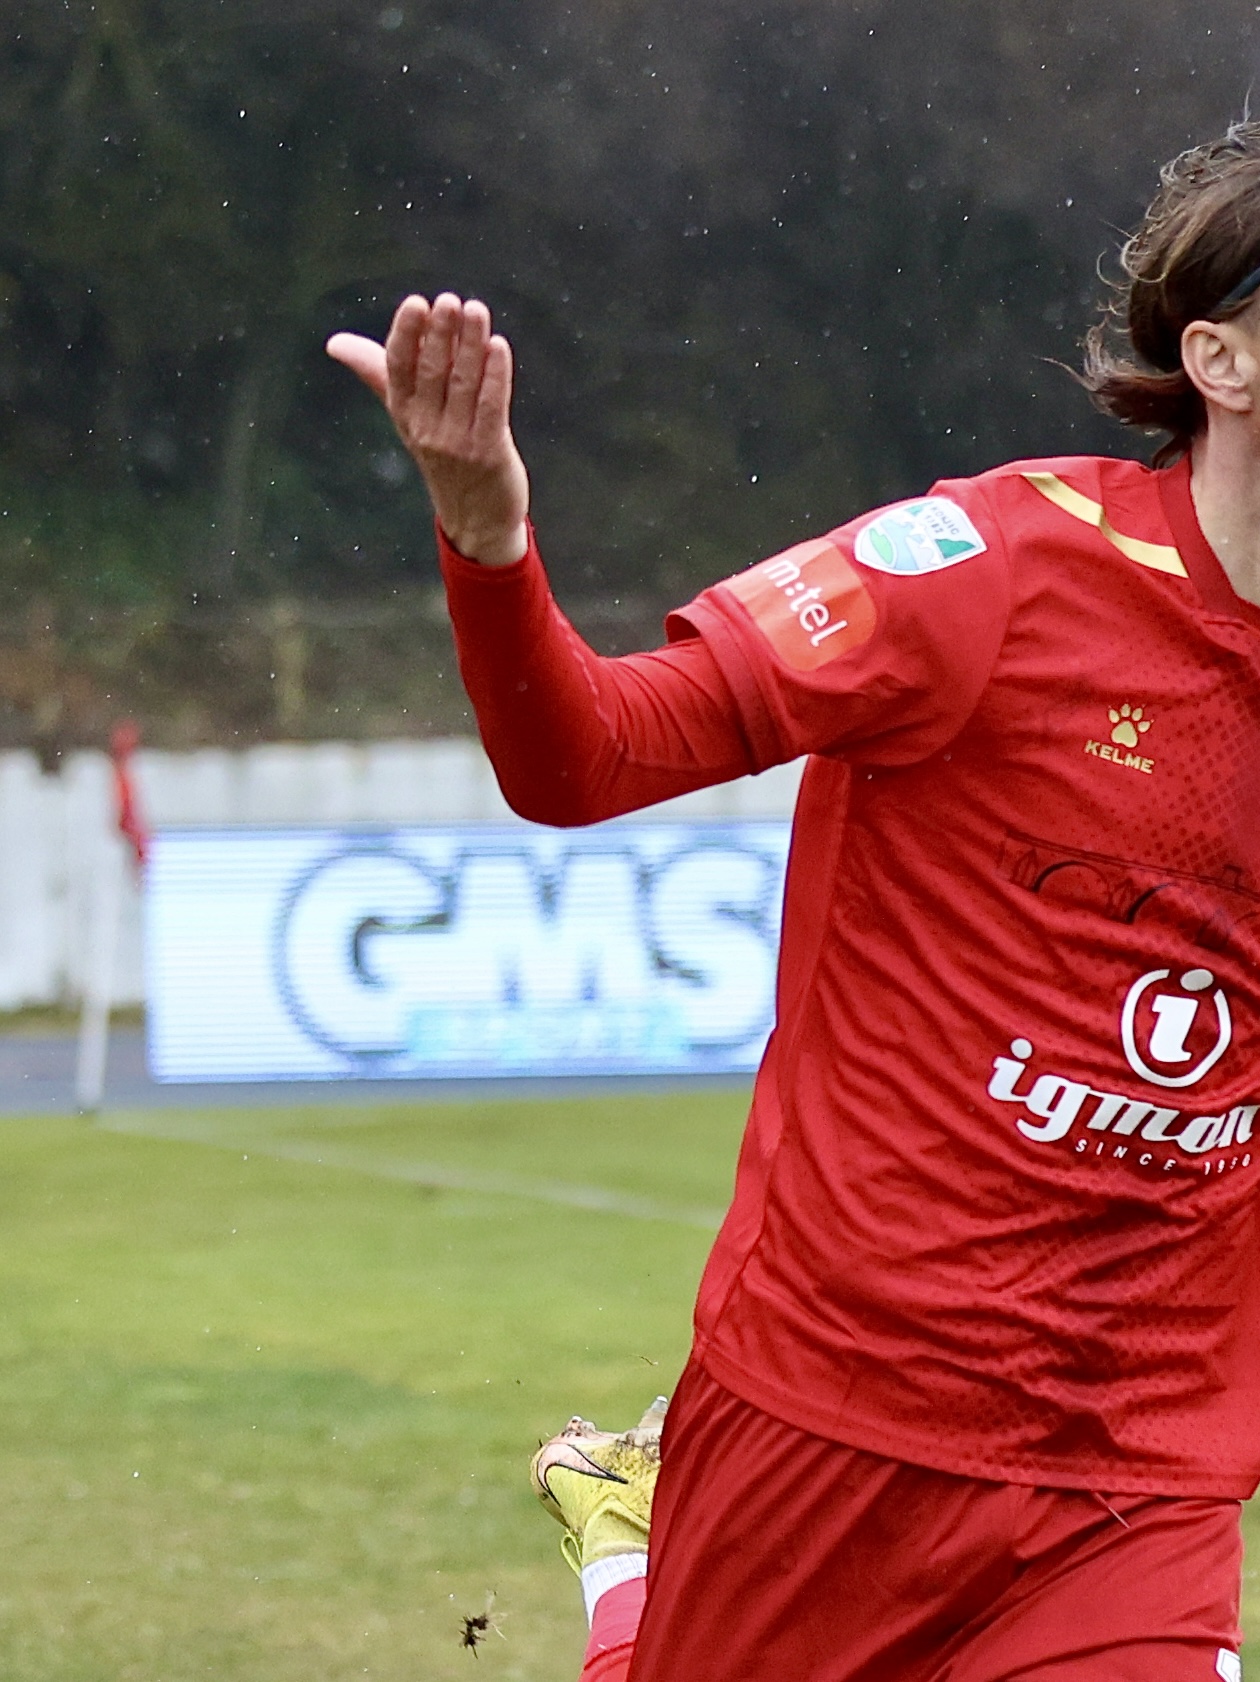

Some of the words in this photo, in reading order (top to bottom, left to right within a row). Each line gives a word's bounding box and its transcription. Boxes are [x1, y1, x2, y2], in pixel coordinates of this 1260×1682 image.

[763, 560, 848, 647] m:tel
[1085, 740, 1155, 774] KELME
[275, 843, 779, 1053] GMS
[1075, 1139, 1177, 1172] SINCE
